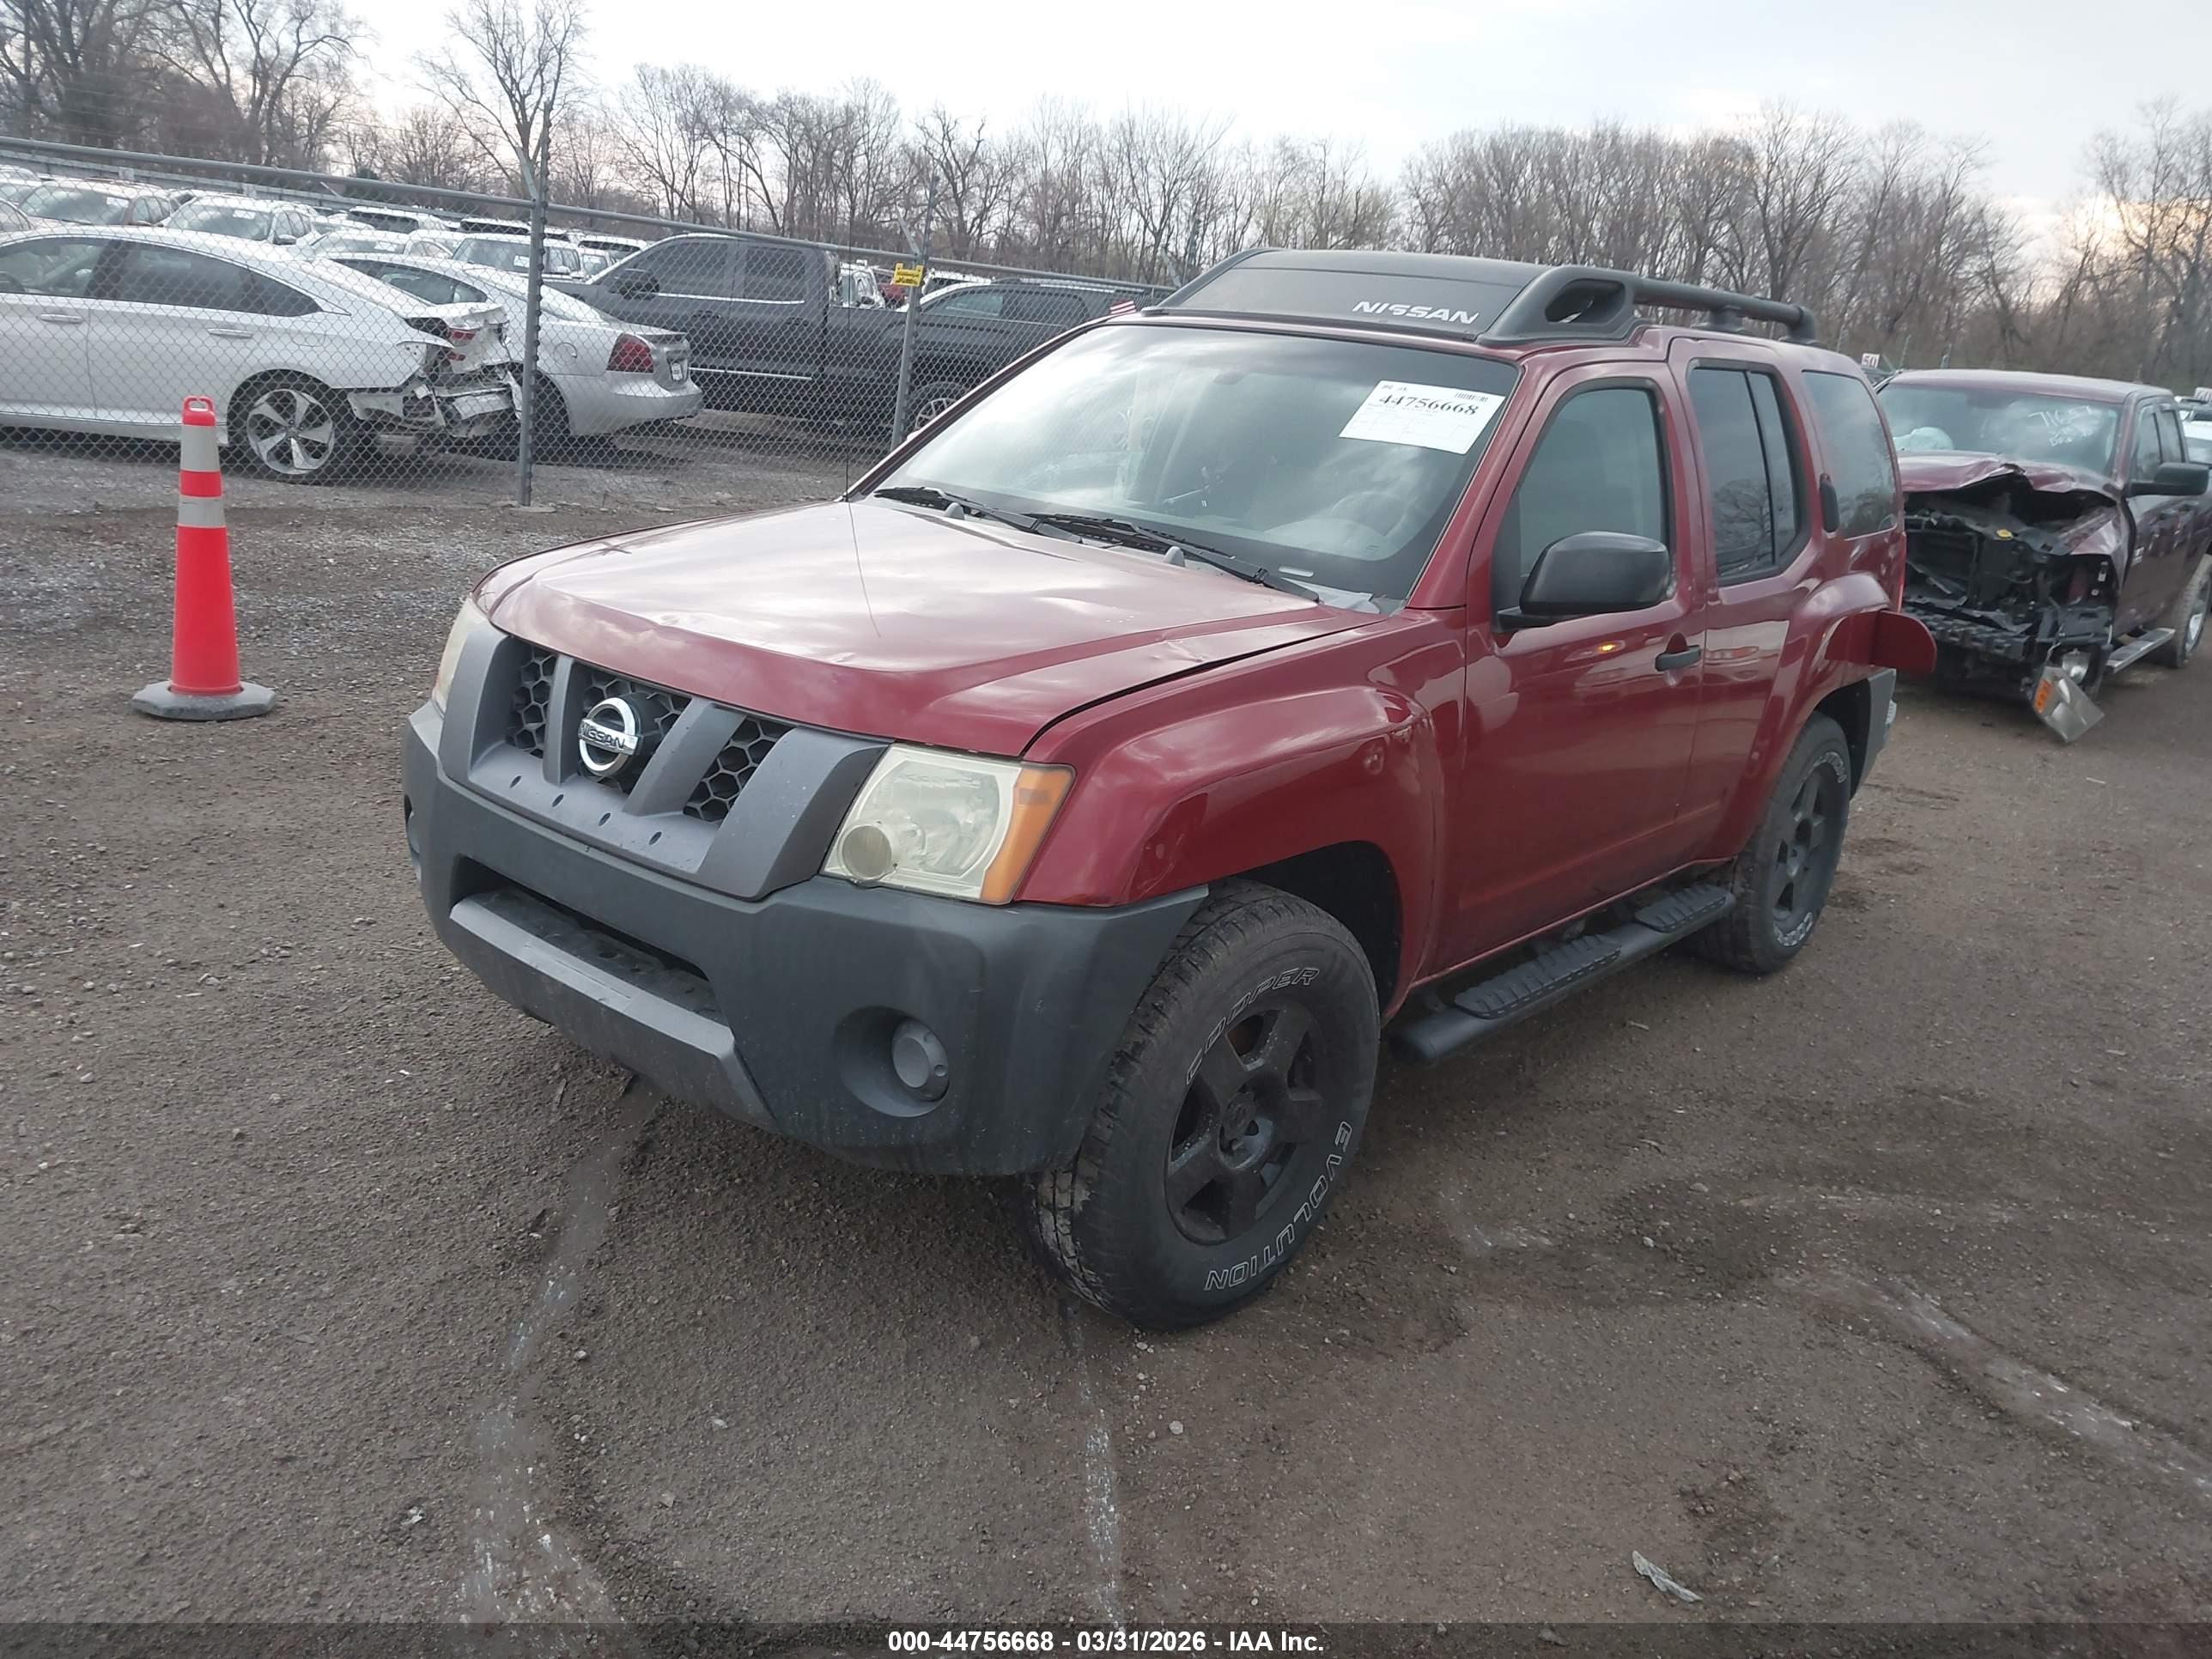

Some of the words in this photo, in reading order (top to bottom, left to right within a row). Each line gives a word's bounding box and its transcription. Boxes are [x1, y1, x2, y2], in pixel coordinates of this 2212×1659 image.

[1352, 301, 1480, 325] NISSAN
[1378, 394, 1480, 416] 44756668
[580, 720, 626, 750] NISSAN
[1186, 967, 1319, 1085] COOPER
[1203, 1121, 1352, 1291] EVOLUTION
